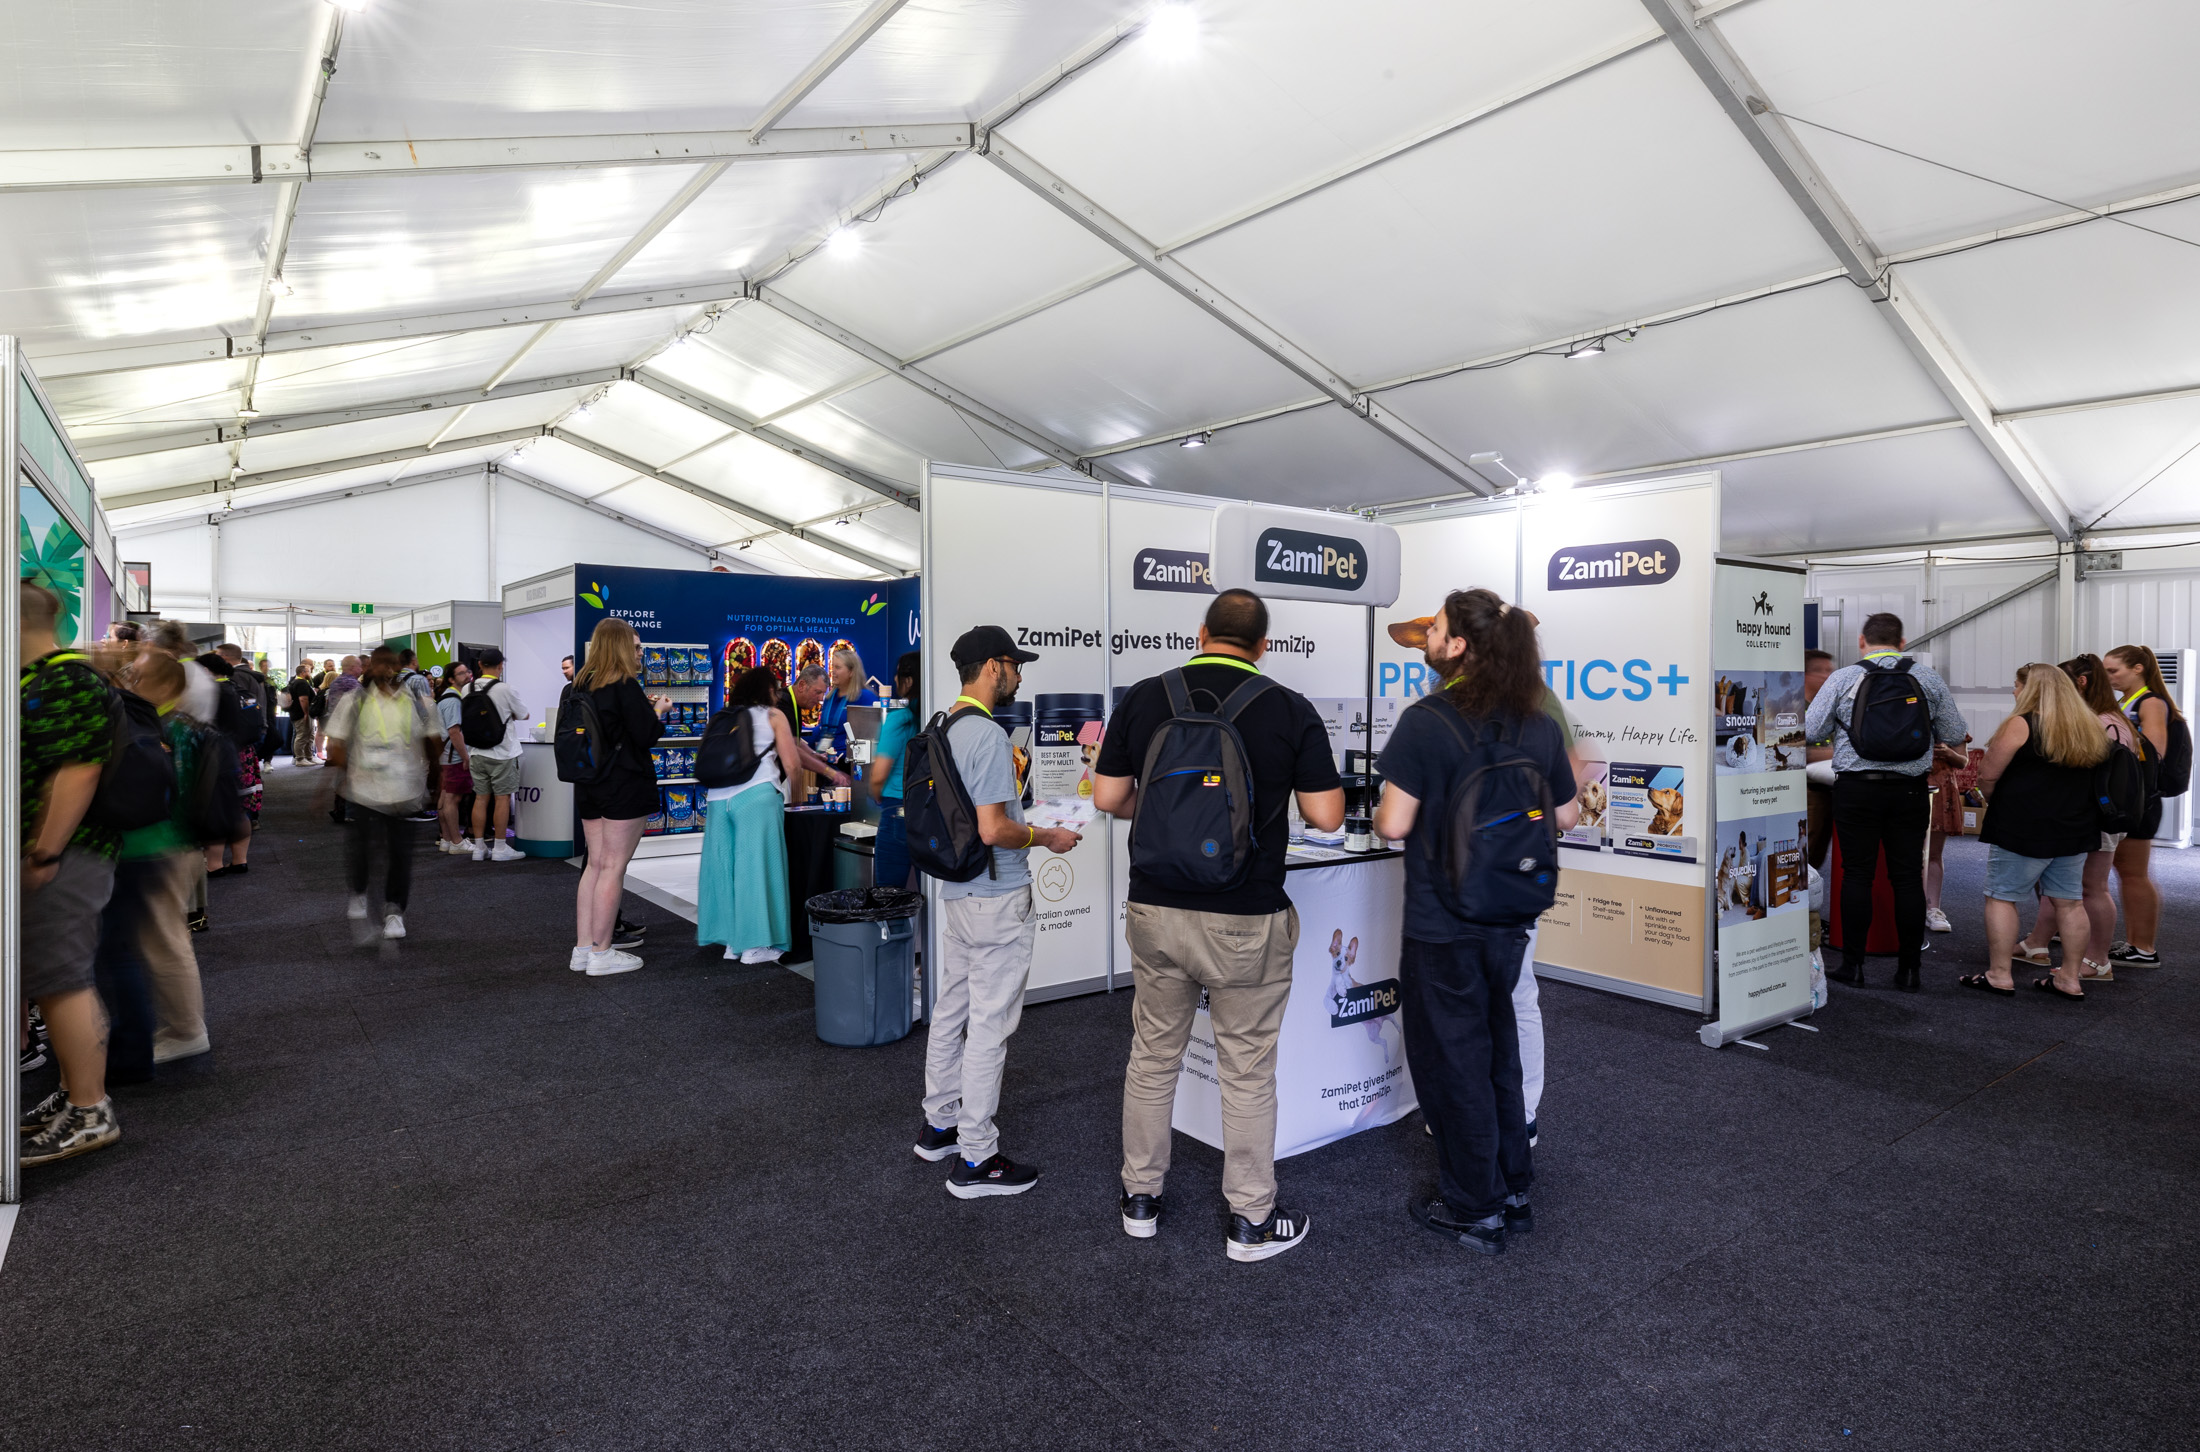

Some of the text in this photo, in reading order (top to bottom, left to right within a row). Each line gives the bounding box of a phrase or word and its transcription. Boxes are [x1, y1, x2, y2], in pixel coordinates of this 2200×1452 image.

[1267, 539, 1358, 579] ZamiPet
[1558, 551, 1666, 580] ZamiPet
[610, 610, 655, 618] EXPLORE
[727, 615, 856, 625] NUTRITIONALLY FORMULATED
[1736, 620, 1790, 636] happy hound
[1017, 627, 1102, 648] ZamiPet
[1111, 628, 1162, 655] gives
[1726, 715, 1756, 727] snooza
[1040, 730, 1074, 741] ZamiPet
[1572, 724, 1698, 745] Tummy, Happy Life.
[1612, 775, 1644, 785] ZamiPet
[1627, 839, 1652, 848] ZamiPet
[1593, 898, 1610, 906] Fridge
[1064, 906, 1090, 916] owned
[1593, 912, 1614, 921] formula
[1645, 906, 1682, 917] Unflavoured
[1048, 920, 1072, 930] made
[1644, 922, 1666, 931] sprinkle
[1338, 987, 1396, 1018] ZamiPet
[1321, 1065, 1403, 1099] ZamiPet gives them
[1339, 1084, 1392, 1111] that ZamiZip.
